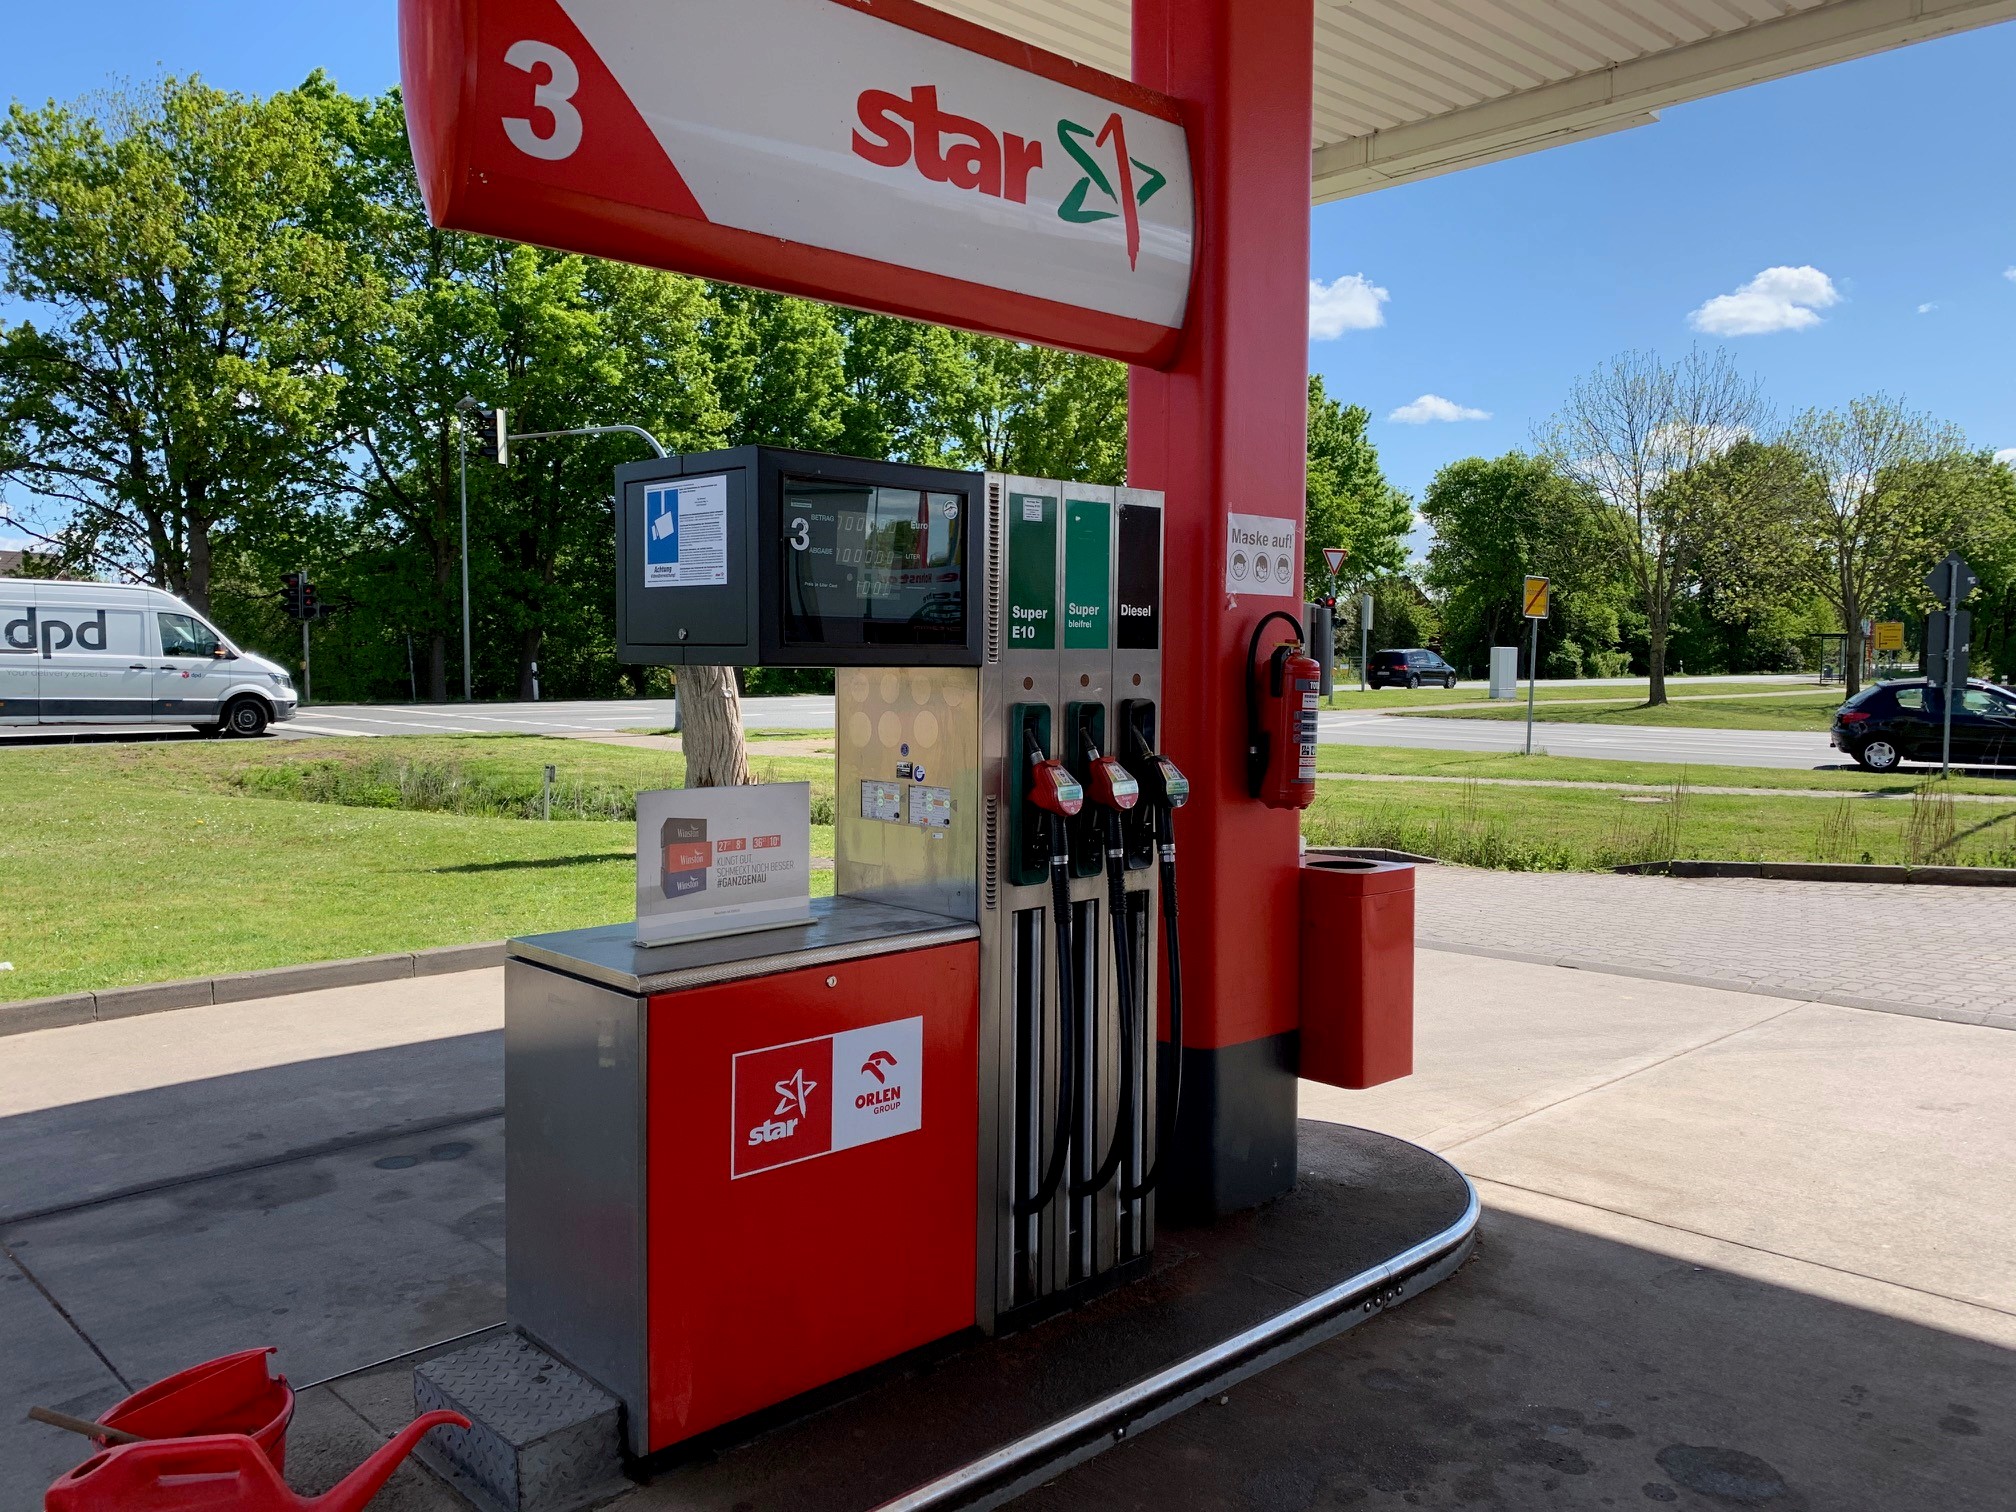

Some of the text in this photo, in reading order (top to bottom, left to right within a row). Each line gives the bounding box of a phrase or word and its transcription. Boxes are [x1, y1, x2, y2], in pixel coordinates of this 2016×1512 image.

[501, 40, 583, 161] 3
[852, 85, 1043, 204] star
[811, 514, 834, 522] BETRAG
[911, 521, 928, 530] Euro
[790, 517, 810, 551] 3
[1232, 528, 1293, 549] Maske auf!
[809, 547, 833, 555] ABGABE
[1012, 606, 1048, 622] Super
[1068, 603, 1099, 619] Super
[1120, 604, 1151, 617] Diesel
[1068, 619, 1092, 629] bleifrei
[4, 607, 108, 659] dpd
[1012, 626, 1035, 639] E10
[6, 669, 108, 679] Your delivery experts
[677, 828, 699, 838] Winston
[680, 854, 704, 865] Winston
[717, 854, 738, 867] KLINGT
[717, 865, 751, 878] SCHMECKT
[752, 863, 769, 874] NOCH
[676, 879, 699, 891] Winston
[717, 873, 767, 888] #GANZGENAU
[855, 1086, 901, 1109] ORLEN
[873, 1101, 901, 1115] GROUP
[748, 1117, 798, 1146] star
